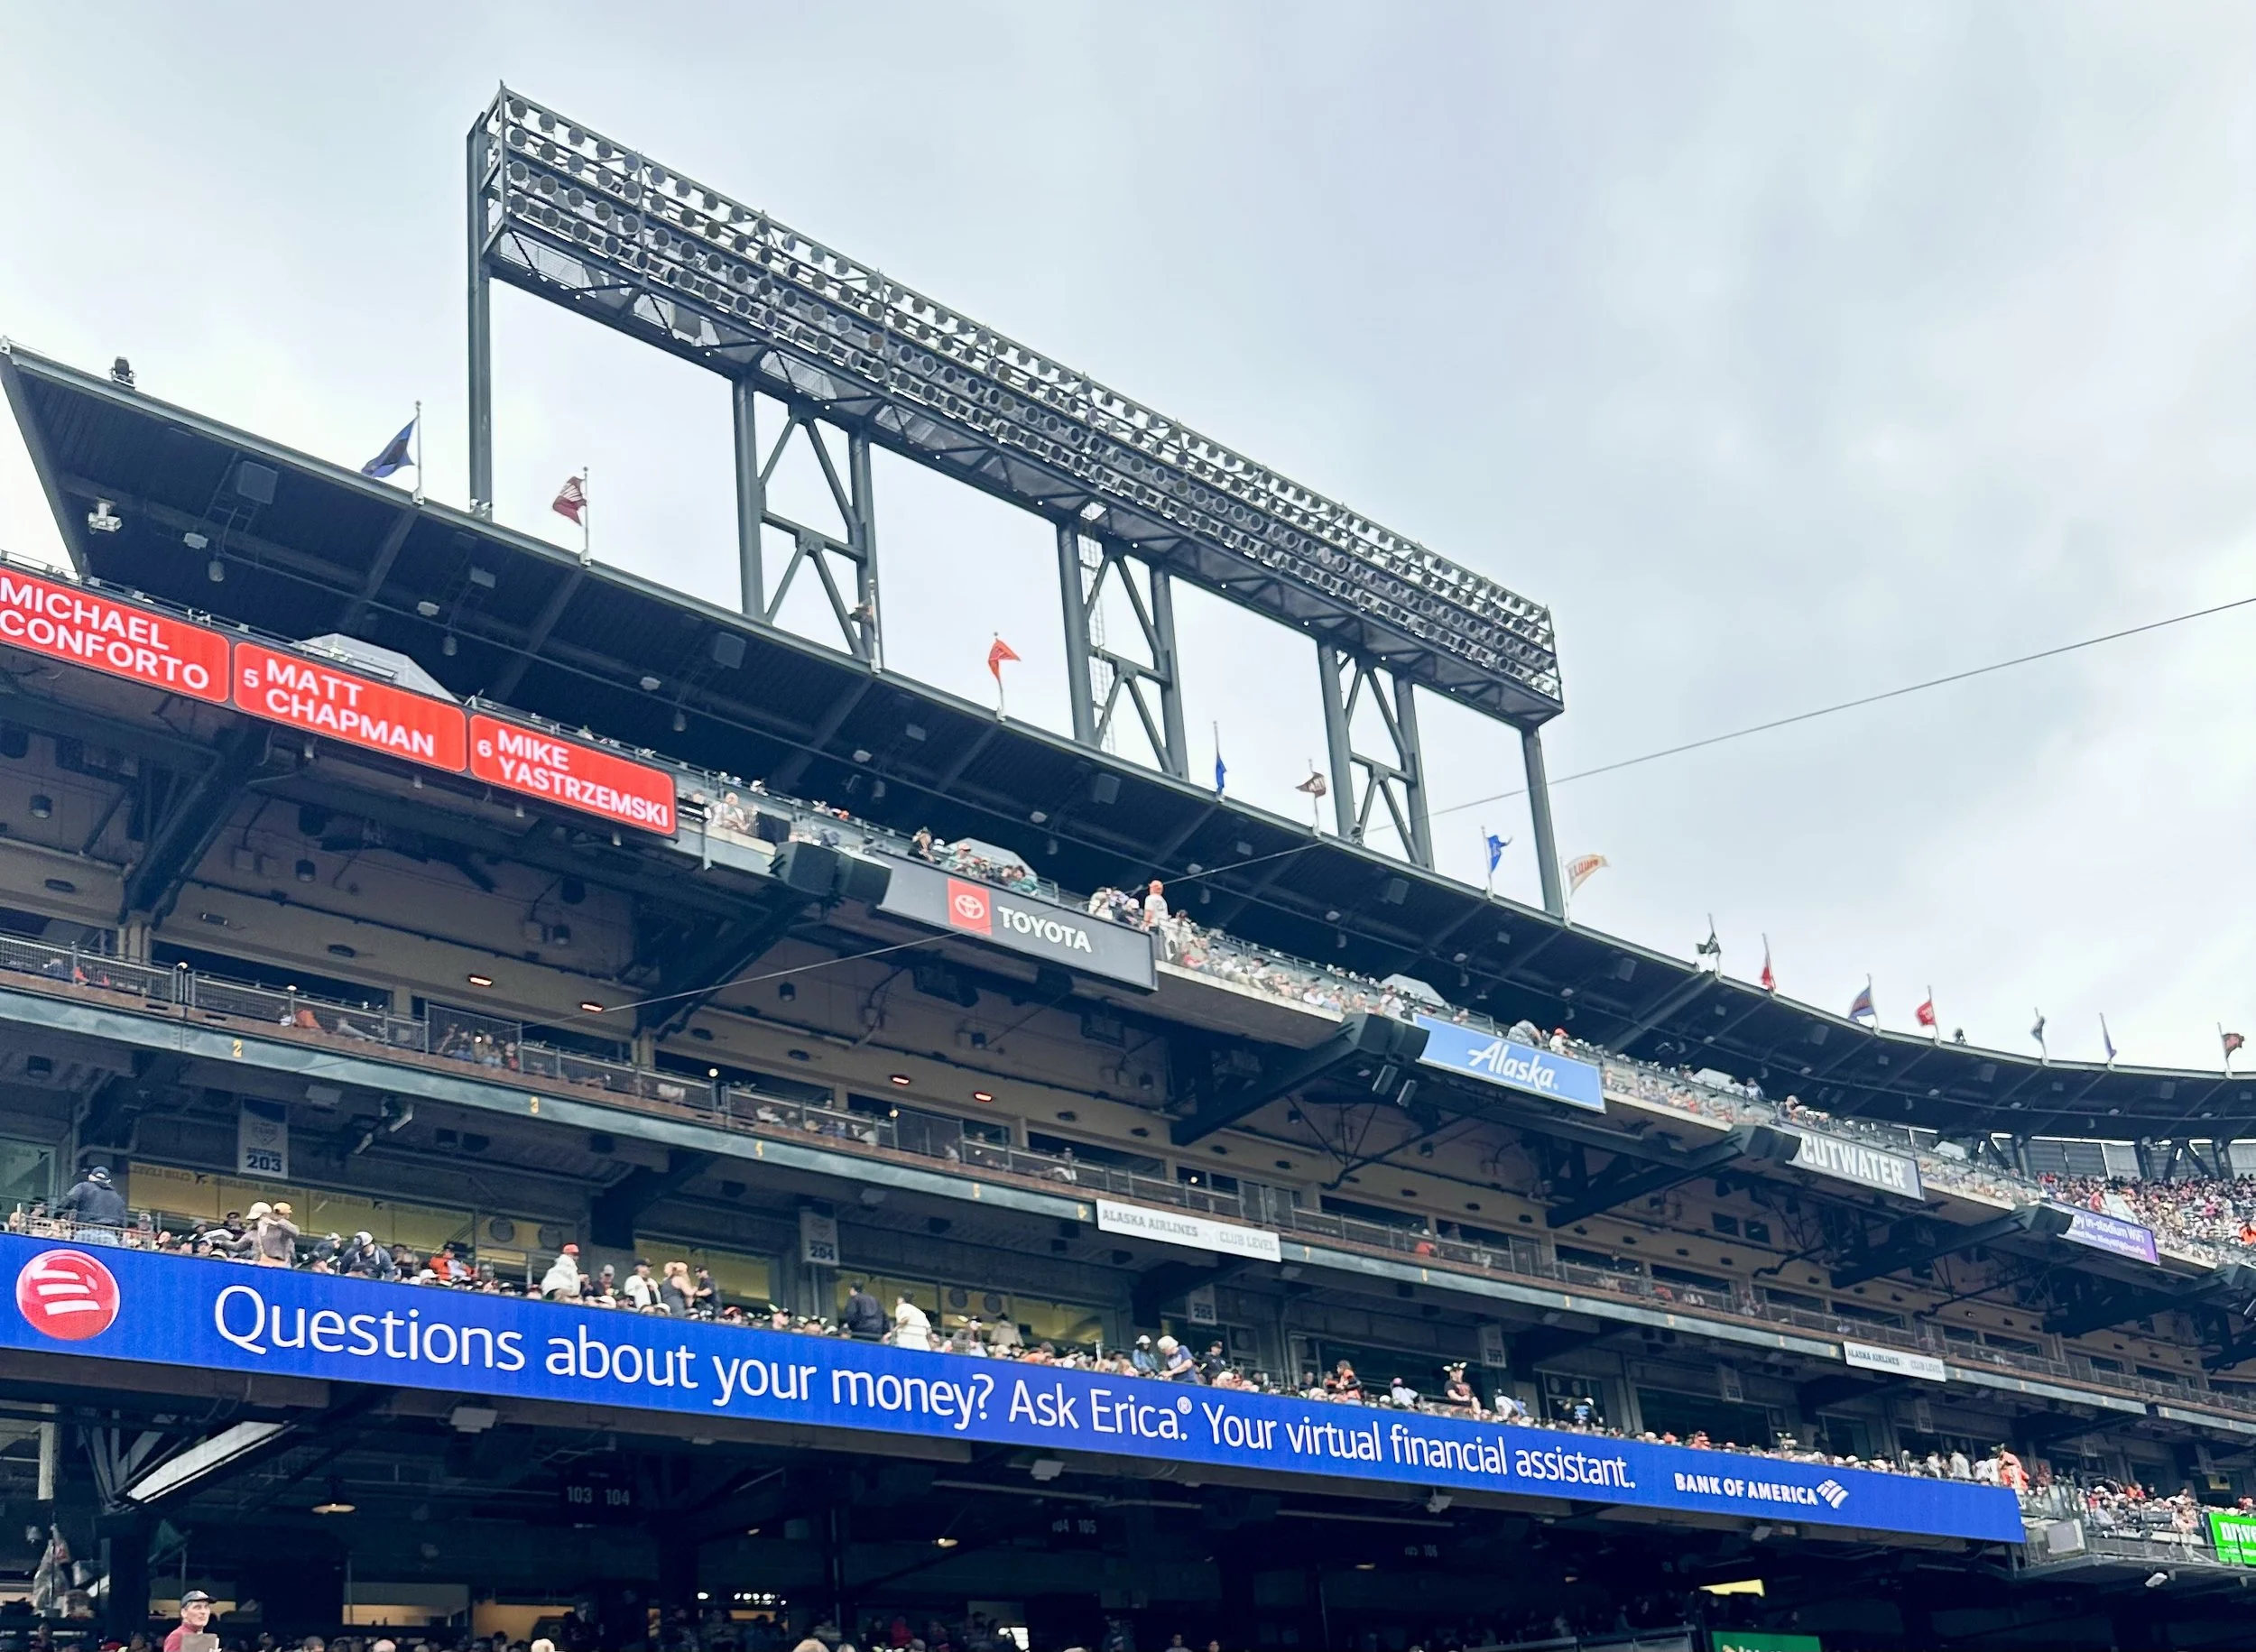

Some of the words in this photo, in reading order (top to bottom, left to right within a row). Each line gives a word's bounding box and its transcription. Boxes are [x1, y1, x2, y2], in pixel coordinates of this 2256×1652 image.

[0, 577, 170, 651] MICHAEL
[0, 609, 209, 689] CONFORTO
[243, 669, 259, 688] 5
[266, 658, 363, 706] MATT
[265, 688, 434, 758] CHAPMAN
[476, 739, 493, 758] 6
[497, 728, 570, 771] MIKE
[498, 756, 669, 827] YASTRZEMSKI
[997, 906, 1093, 953] TOYOTA
[232, 1039, 244, 1058] 2
[1467, 1040, 1556, 1091] Alaska
[246, 1155, 282, 1172] 203
[1800, 1132, 1906, 1189] CUTWATER
[1103, 1209, 1146, 1228] ALASKA
[1148, 1217, 1198, 1237] AIRLINES
[1219, 1231, 1245, 1246] CLUB
[1246, 1235, 1276, 1251] LEVEL
[214, 1285, 526, 1371] Questions
[545, 1324, 699, 1389] about
[711, 1355, 818, 1407] your
[832, 1369, 994, 1431] money?
[1008, 1379, 1080, 1430] Ask
[1202, 1401, 1278, 1451] Your
[1286, 1416, 1382, 1463] virtual
[1390, 1423, 1508, 1475] financial
[1515, 1445, 1637, 1489] assistant.
[567, 1485, 593, 1504] 103
[605, 1488, 630, 1506] 104
[1674, 1472, 1722, 1495] BANK
[1723, 1478, 1745, 1498] OF
[1747, 1481, 1819, 1506] AMERICA
[1077, 1519, 1097, 1537] 105
